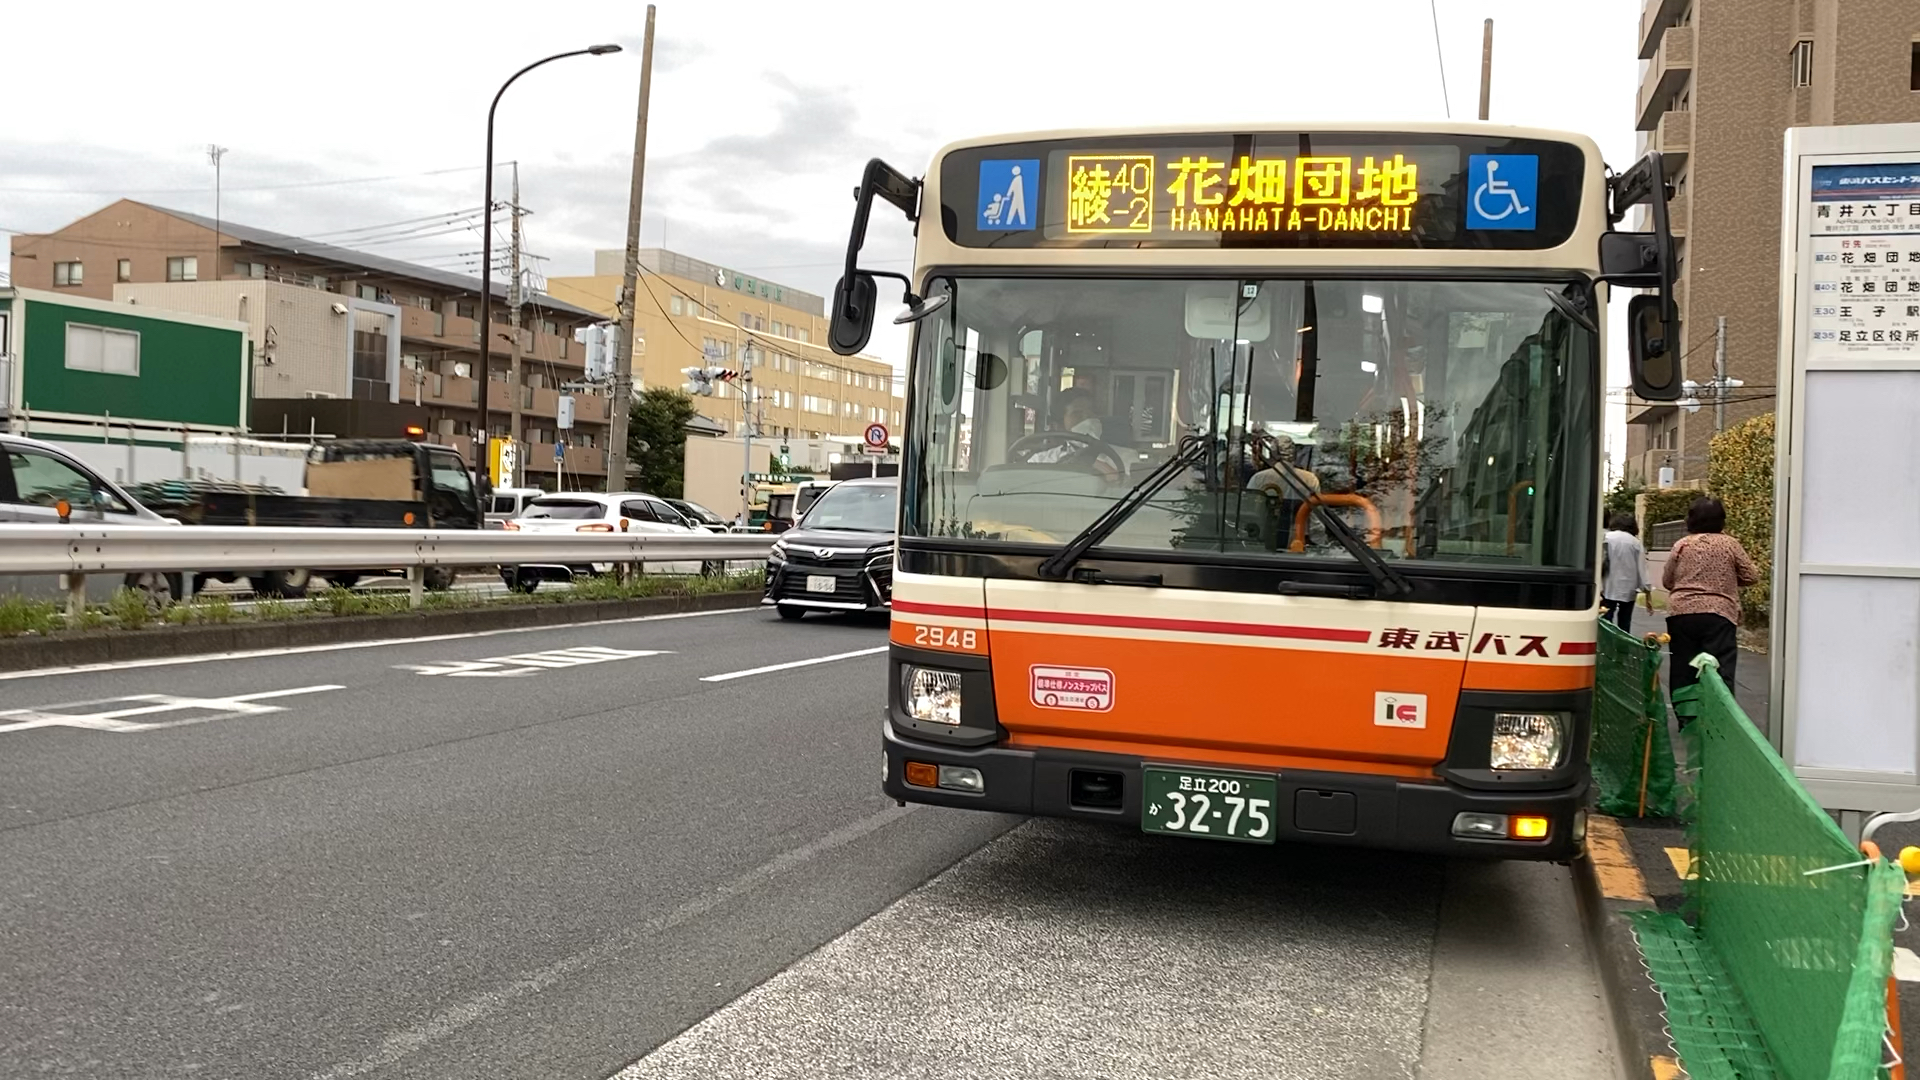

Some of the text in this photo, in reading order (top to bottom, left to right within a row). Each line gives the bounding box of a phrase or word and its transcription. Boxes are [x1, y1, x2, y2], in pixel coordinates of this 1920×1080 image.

[1112, 163, 1150, 194] 40
[1166, 154, 1418, 207] 花畑団地
[1072, 164, 1111, 226] 綾
[1170, 207, 1413, 232] HANAHATA-DANCHI
[1817, 203, 1920, 218] 青井六丁目
[1841, 252, 1920, 263] 花畑団地
[1840, 281, 1920, 293] 花畑団地
[1840, 306, 1920, 317] 王子駅
[1839, 330, 1919, 341] 足立区役所
[915, 625, 977, 650] 2948
[1377, 627, 1550, 658] 東武バス
[1148, 791, 1270, 838] か 32-75
